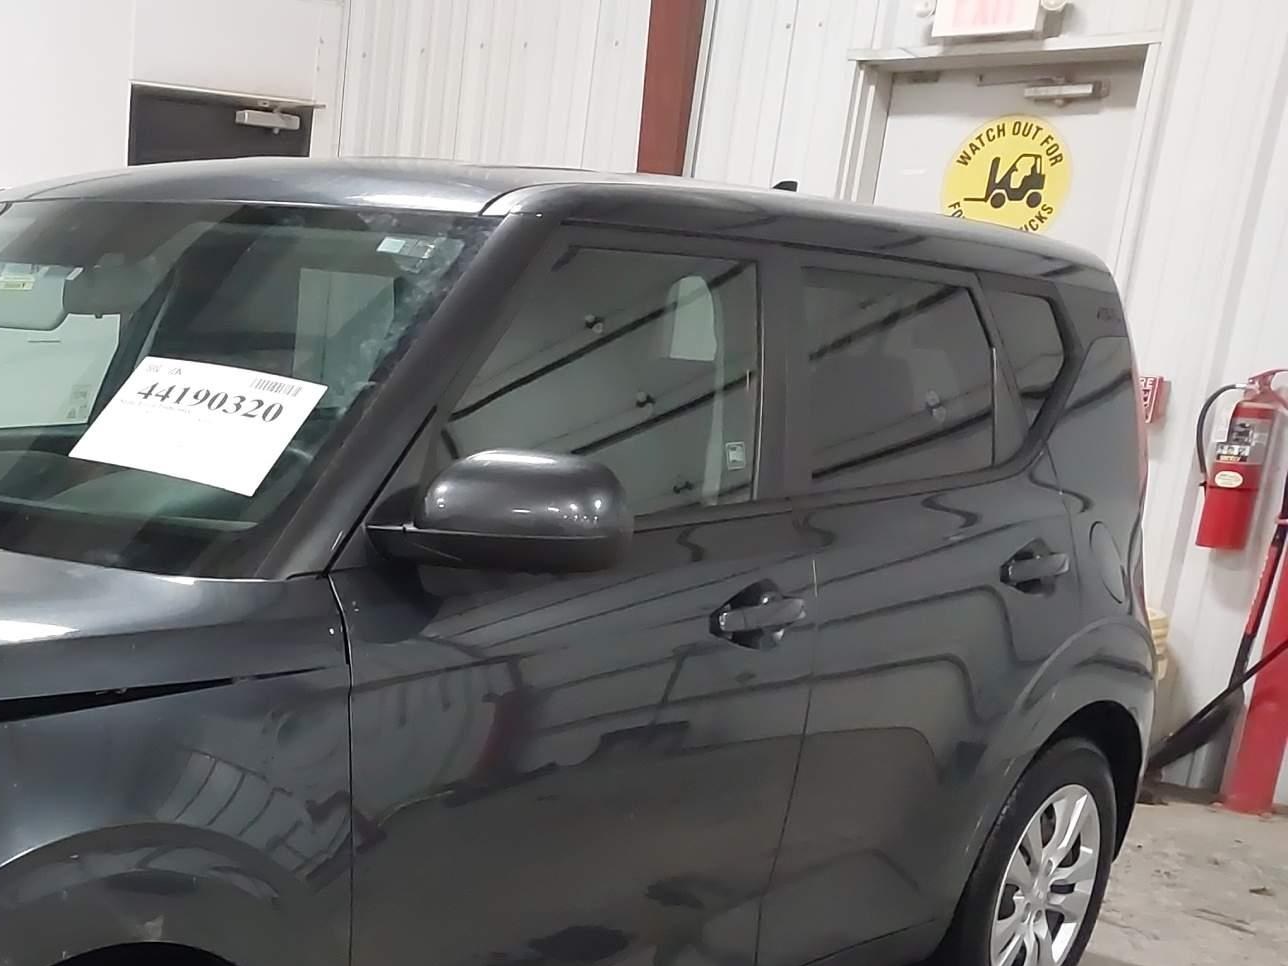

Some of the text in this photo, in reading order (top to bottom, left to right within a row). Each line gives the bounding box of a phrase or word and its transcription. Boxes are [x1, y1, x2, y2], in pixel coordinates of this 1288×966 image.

[956, 120, 1064, 167] WATCH OUT FOR
[137, 382, 284, 423] 44190320
